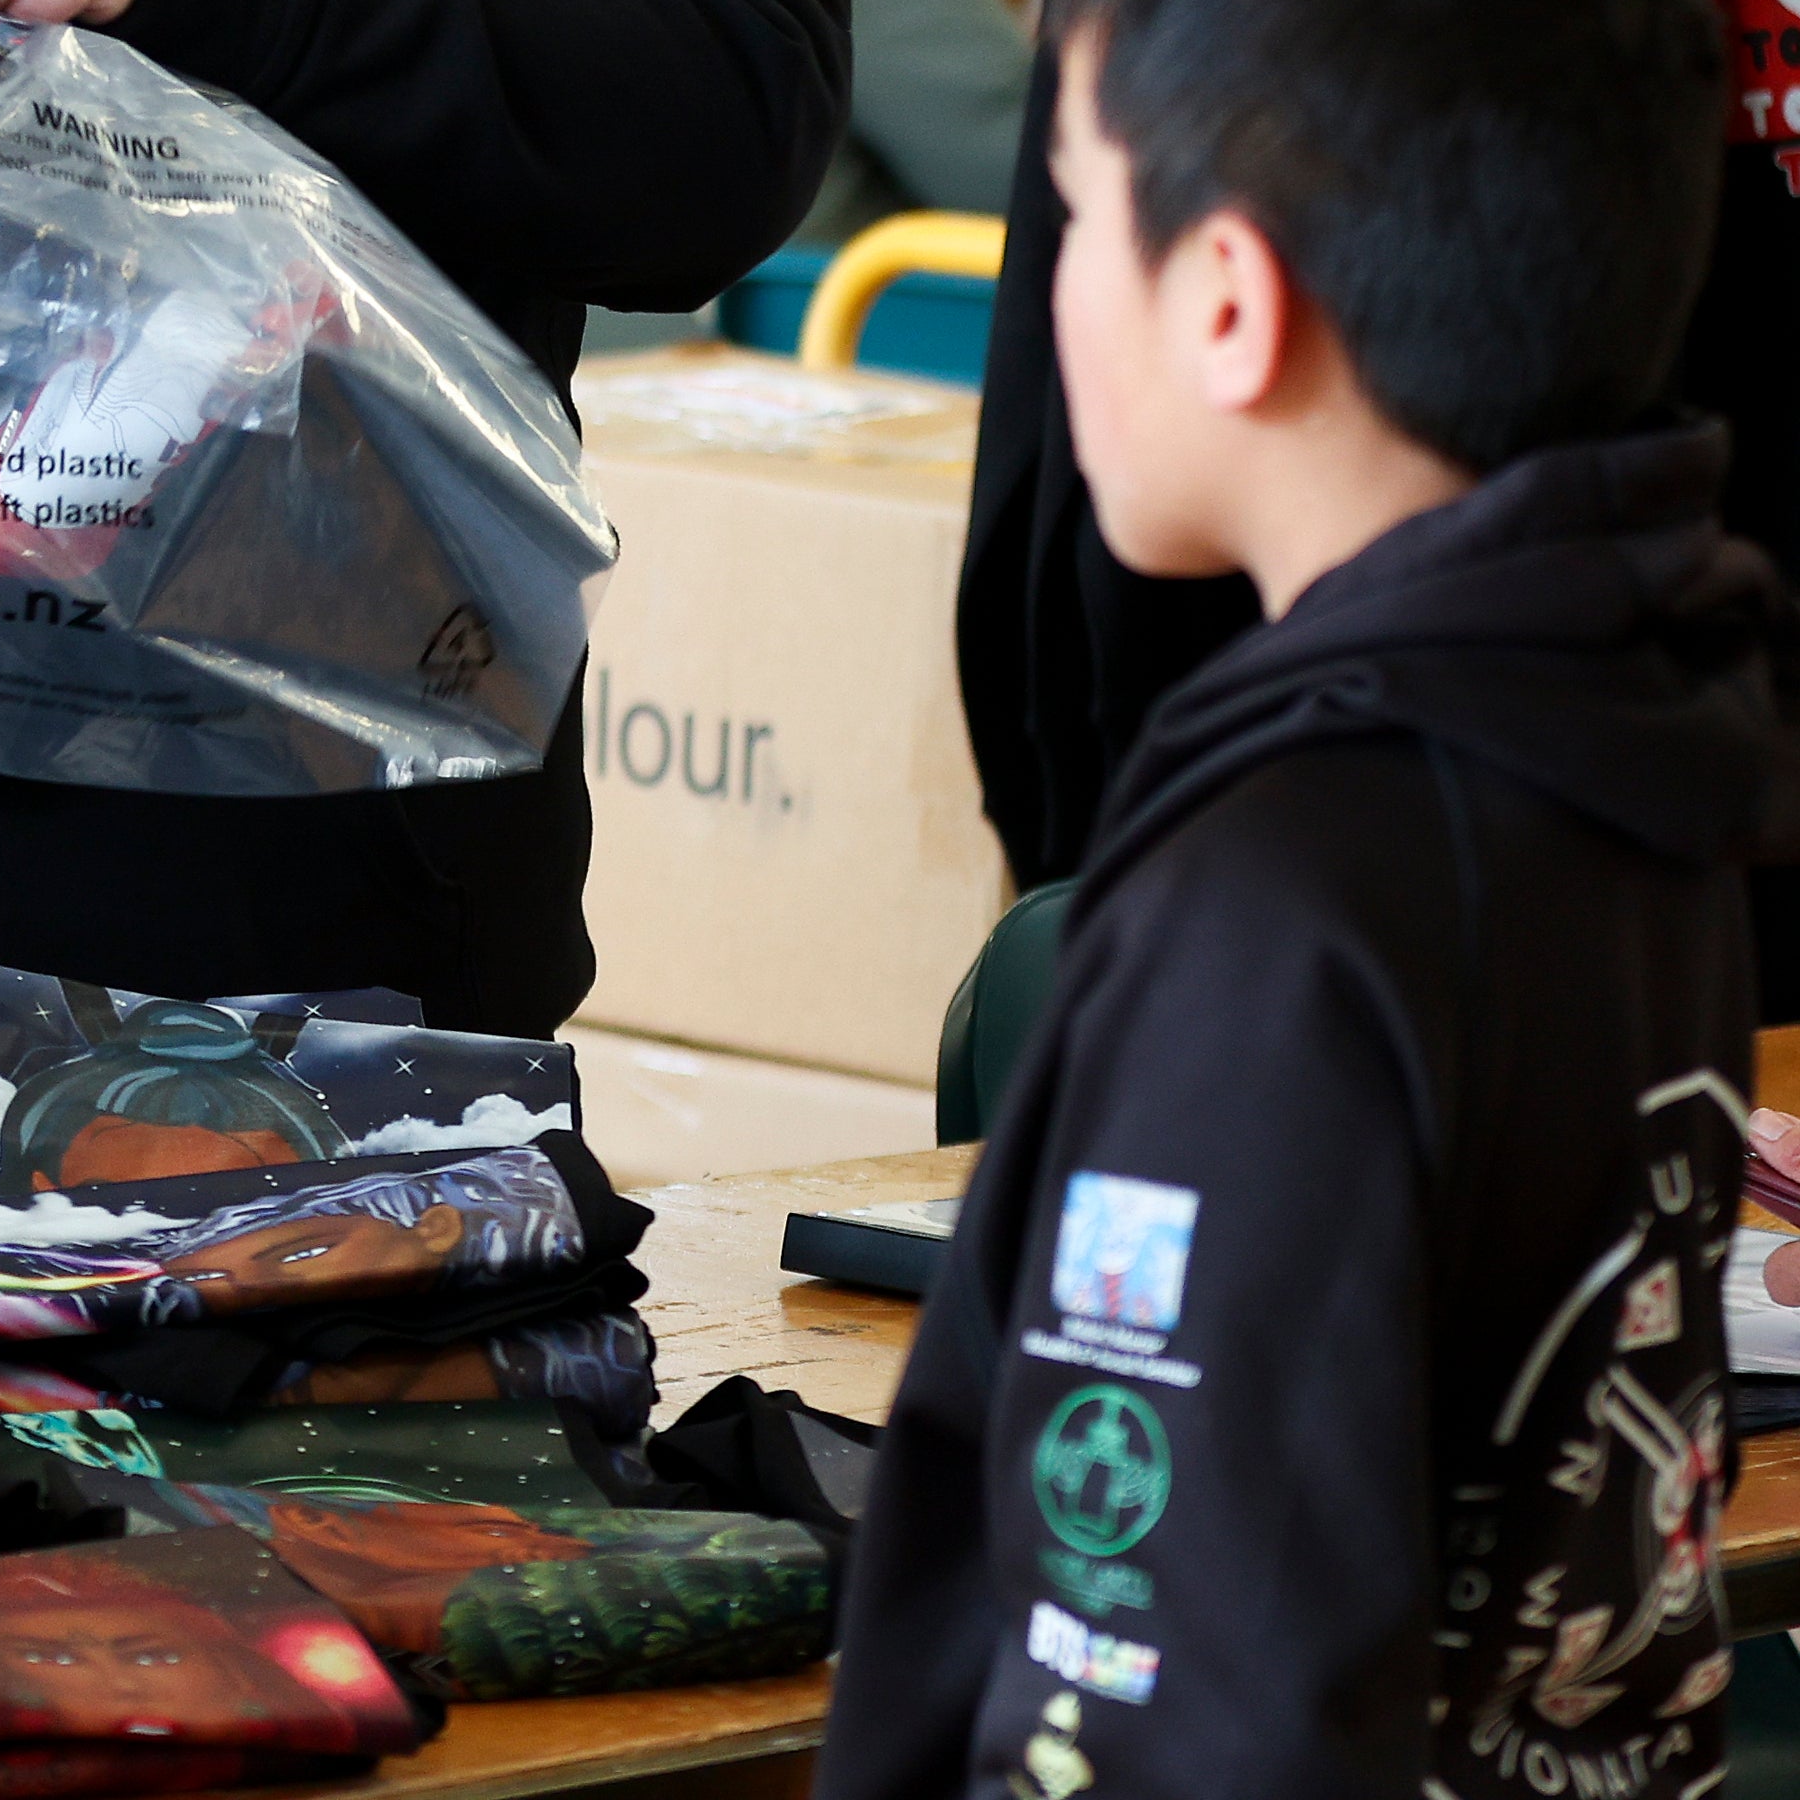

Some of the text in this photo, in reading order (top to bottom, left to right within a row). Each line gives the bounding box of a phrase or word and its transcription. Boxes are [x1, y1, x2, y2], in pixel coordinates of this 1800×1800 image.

[32, 100, 180, 161] WARNING
[37, 450, 143, 481] plastic
[35, 496, 158, 529] plastics
